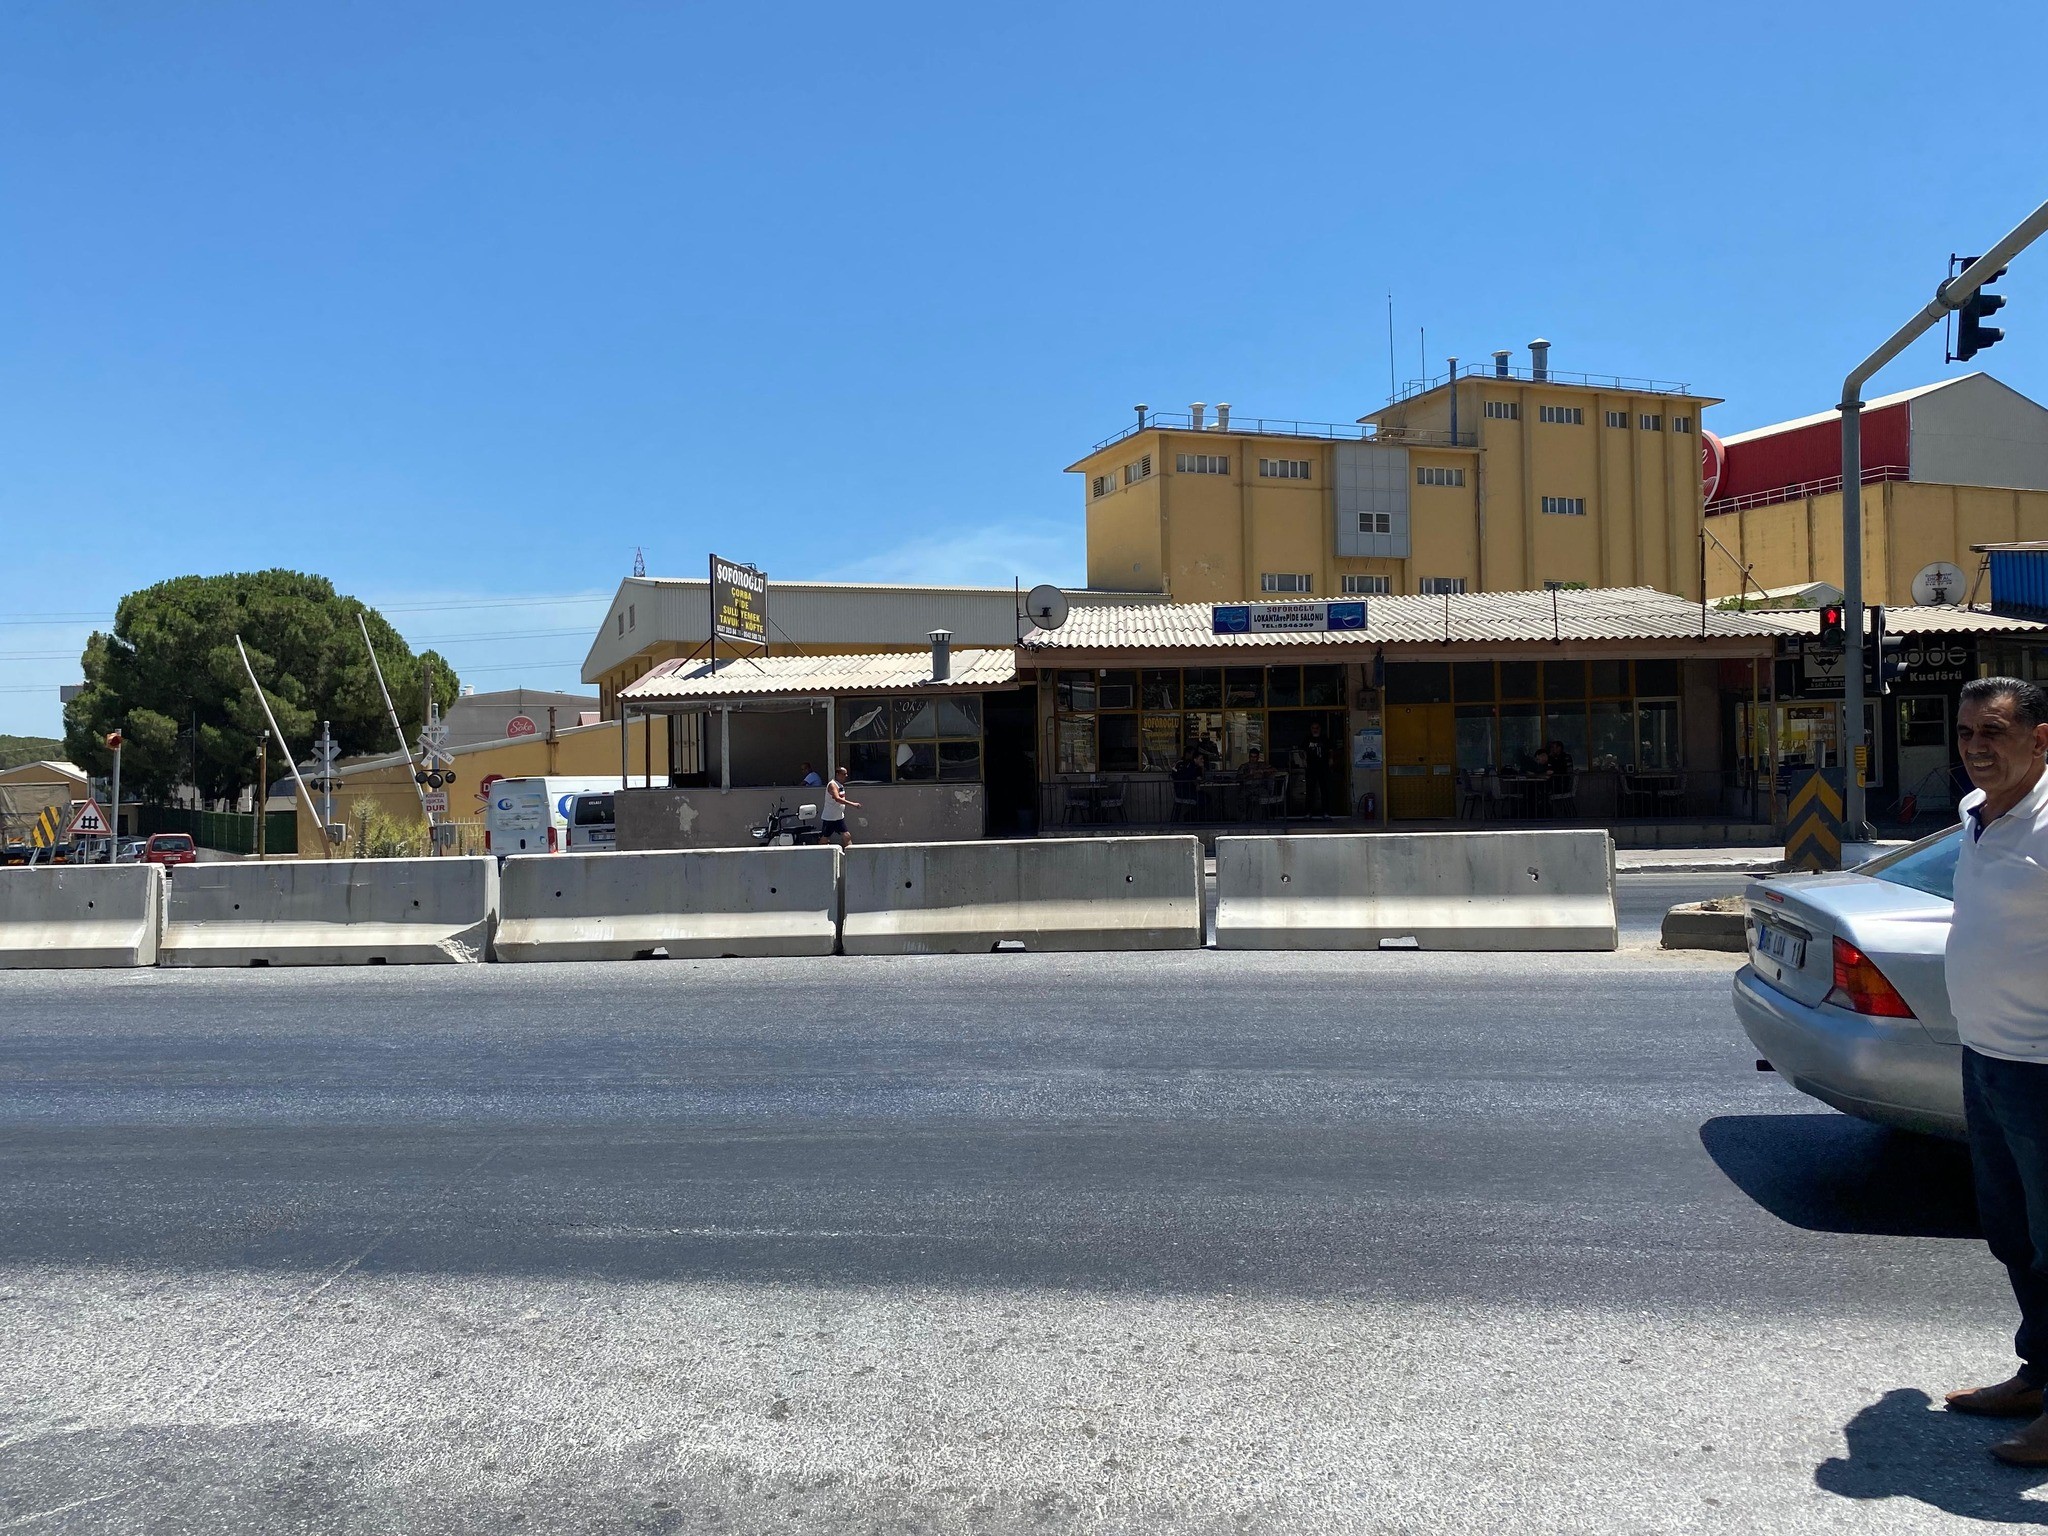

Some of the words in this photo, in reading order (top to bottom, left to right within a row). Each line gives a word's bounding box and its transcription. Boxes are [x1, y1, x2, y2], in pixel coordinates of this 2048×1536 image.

[716, 564, 764, 594] ŞOFÖROĞLU
[731, 587, 752, 601] ÇORBA
[740, 610, 760, 622] YEMEK
[1300, 613, 1324, 621] SALONU
[745, 620, 764, 634] KÖFTE
[1910, 670, 1962, 682] Kuaförü
